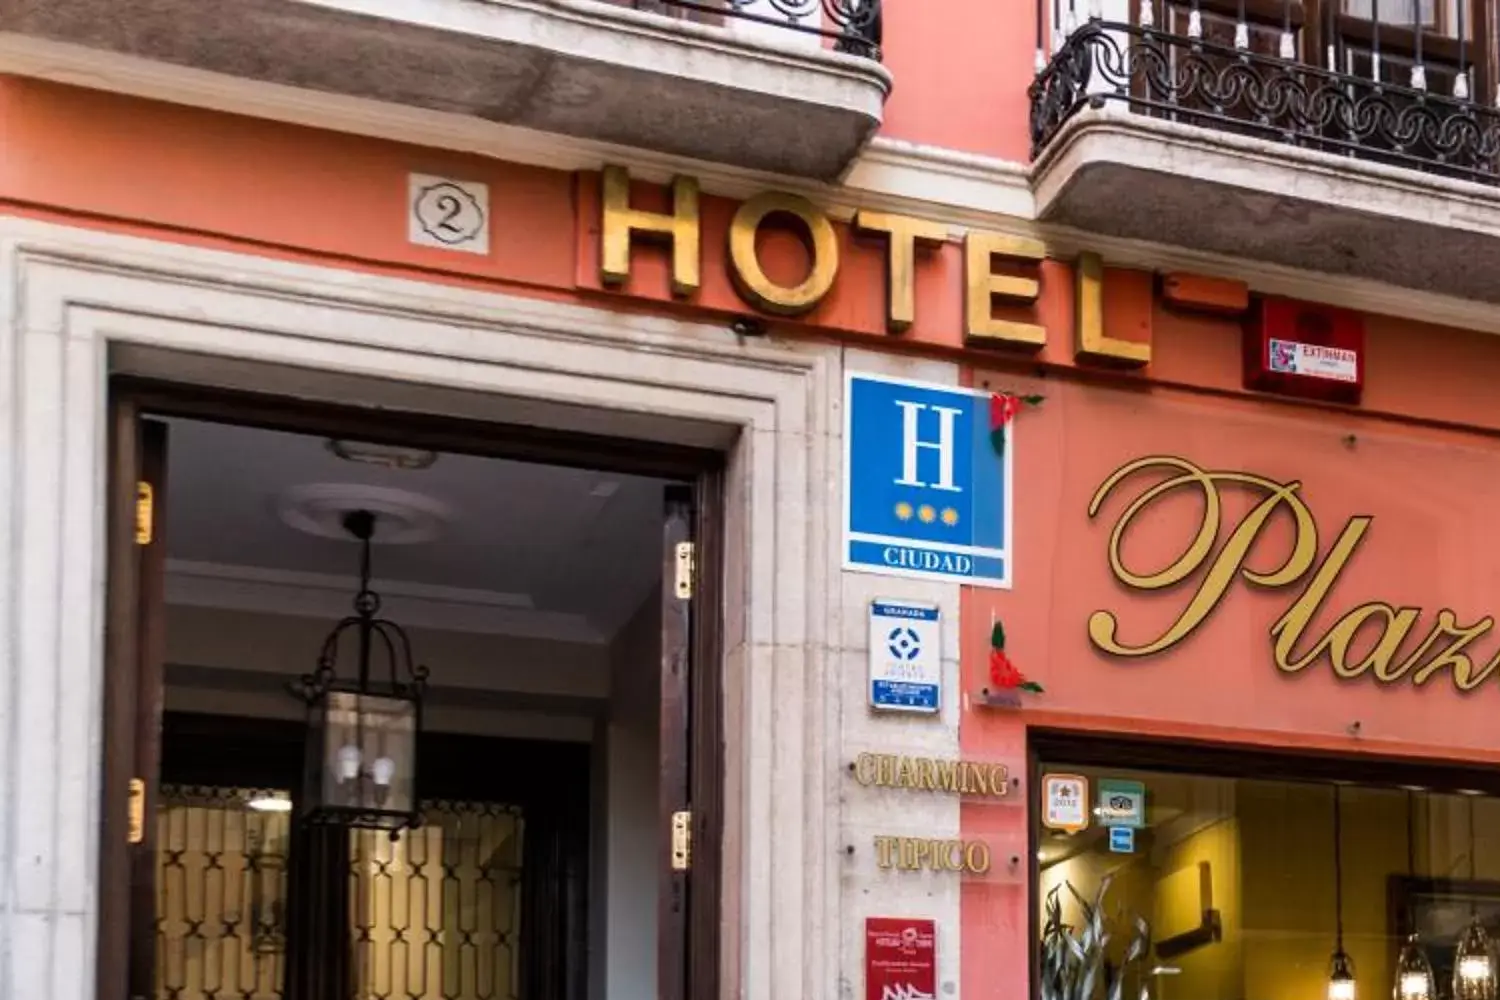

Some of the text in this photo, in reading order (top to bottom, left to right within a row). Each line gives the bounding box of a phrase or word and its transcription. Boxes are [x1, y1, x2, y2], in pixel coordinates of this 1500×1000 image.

[437, 195, 464, 233] 2
[601, 162, 1151, 368] HOTEL
[893, 399, 964, 492] H
[883, 547, 972, 575] CIUDAD
[855, 752, 1008, 796] CHARMING
[873, 834, 991, 874] TIPICO
